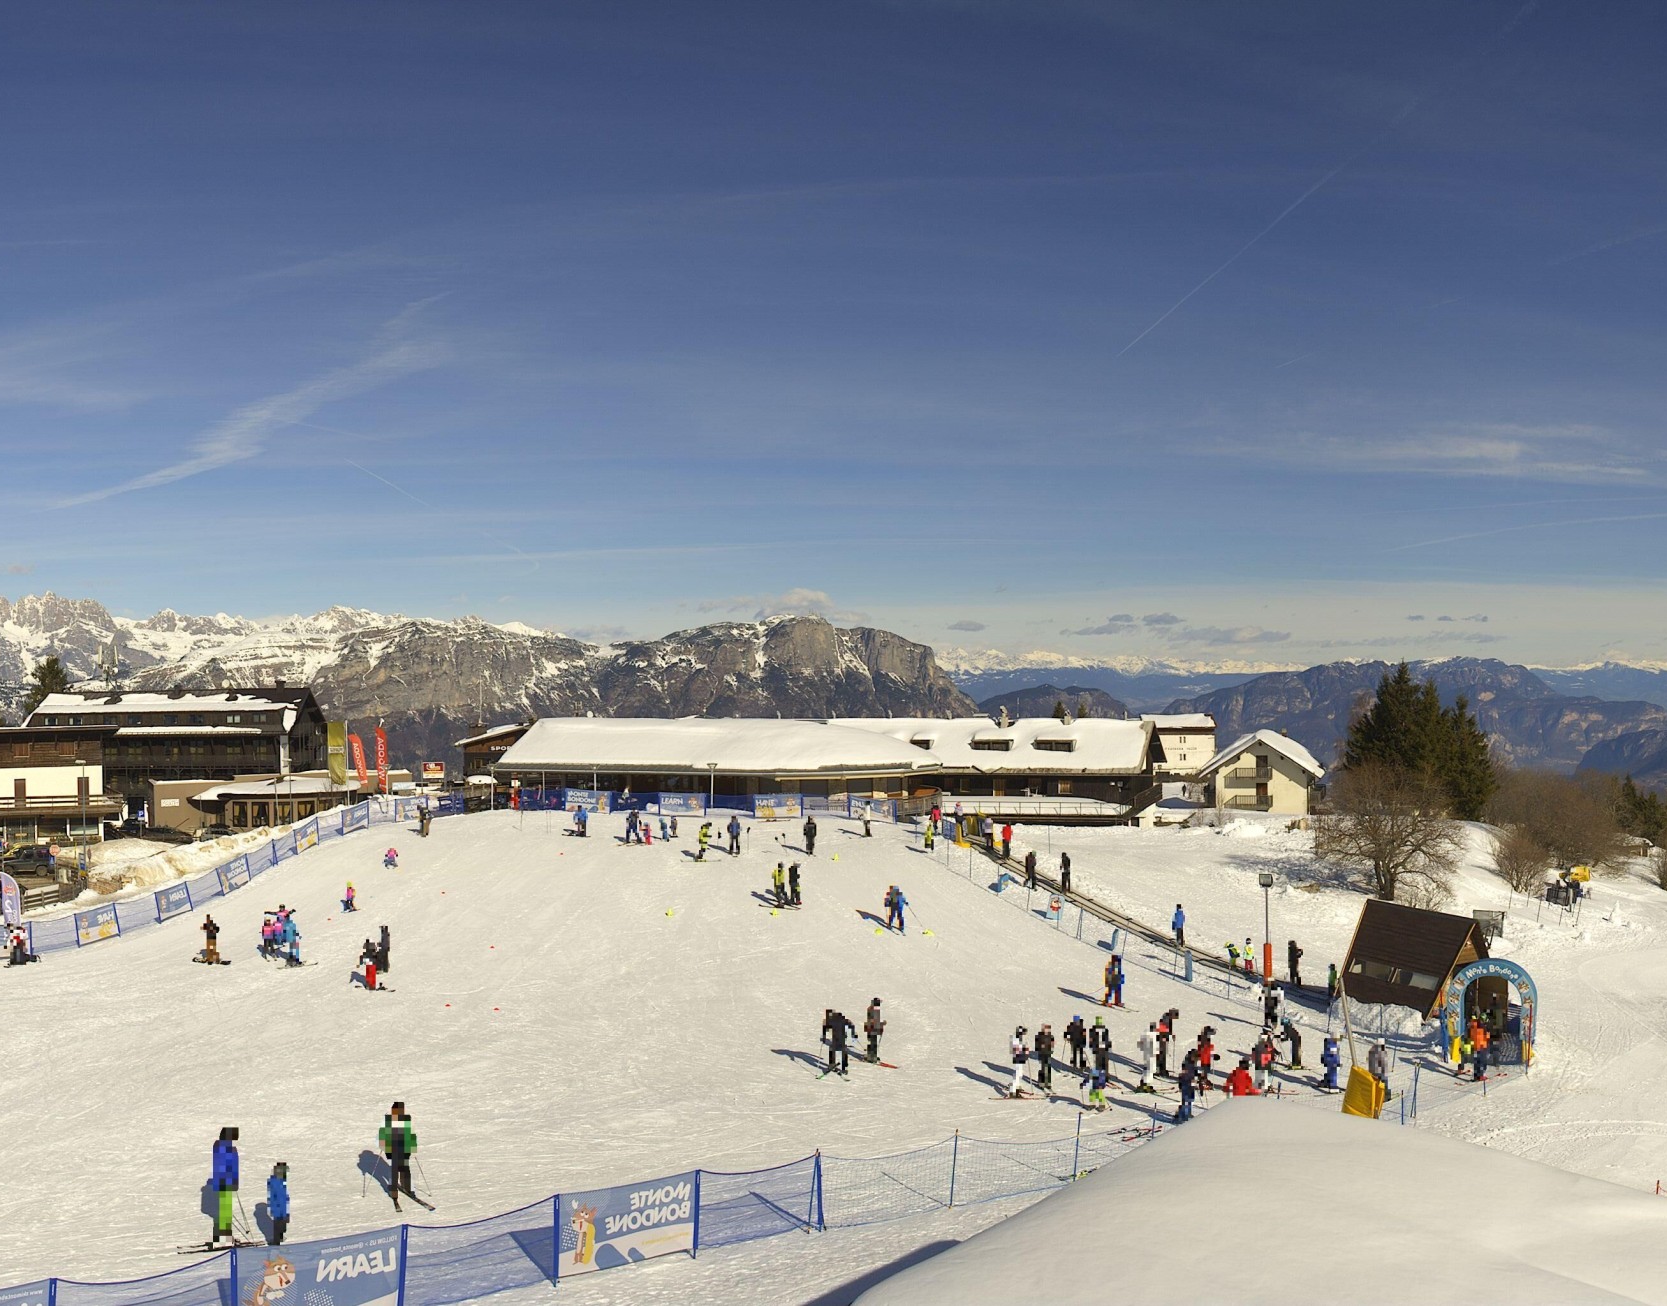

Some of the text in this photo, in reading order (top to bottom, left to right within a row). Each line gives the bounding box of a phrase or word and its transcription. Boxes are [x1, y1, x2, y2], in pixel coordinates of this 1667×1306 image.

[661, 797, 683, 805] LEARN
[1465, 964, 1519, 979] Monte Bondone
